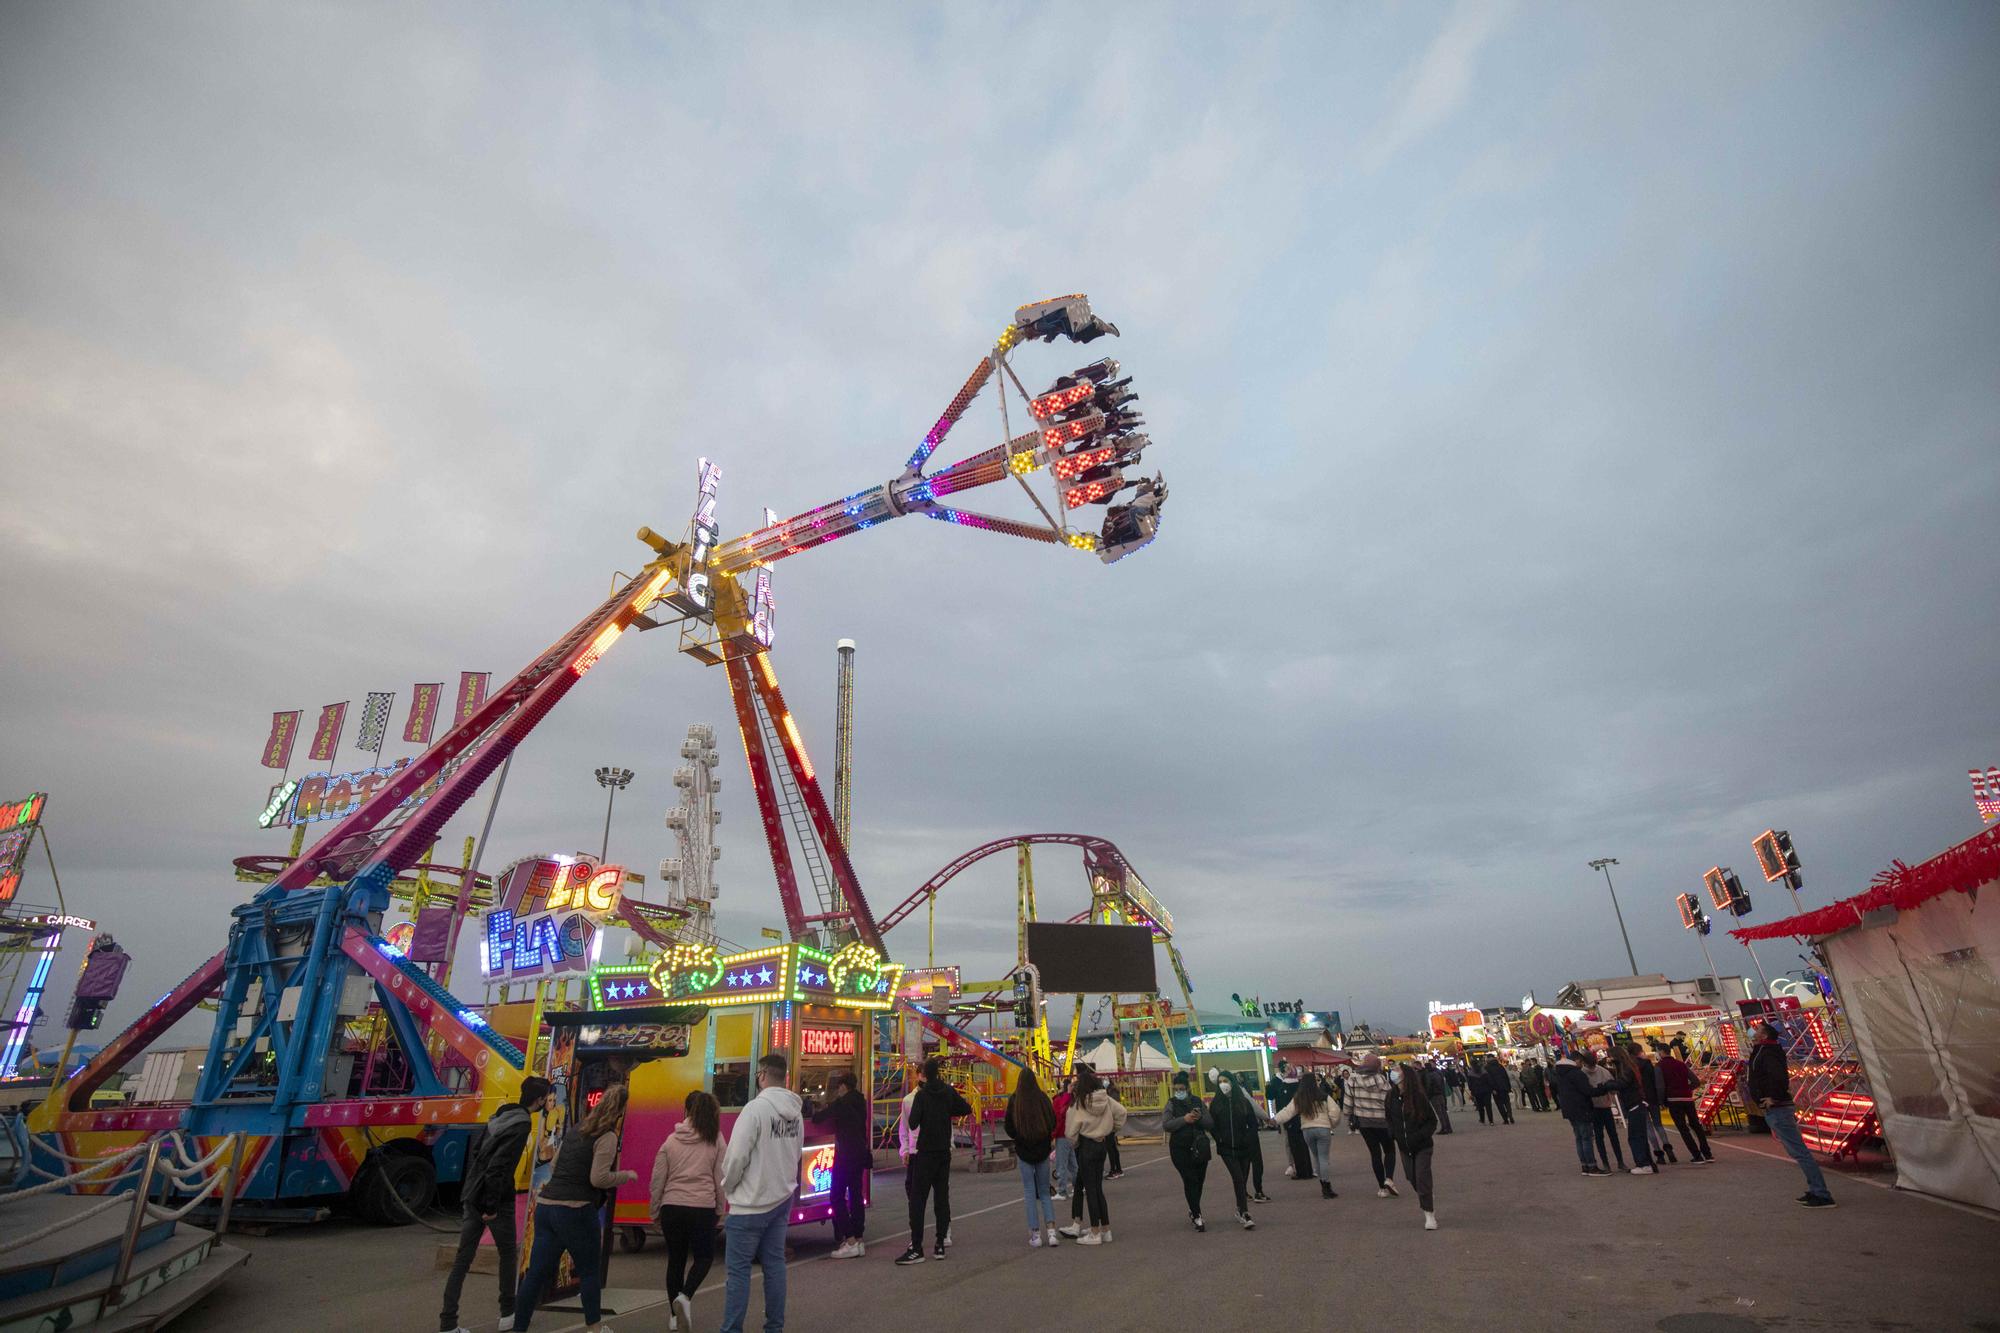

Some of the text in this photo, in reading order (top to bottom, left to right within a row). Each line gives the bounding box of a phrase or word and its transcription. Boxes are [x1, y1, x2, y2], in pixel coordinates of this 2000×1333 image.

[258, 780, 298, 828] SUPER
[46, 914, 95, 931] CARCEL
[486, 908, 585, 971] FLAC
